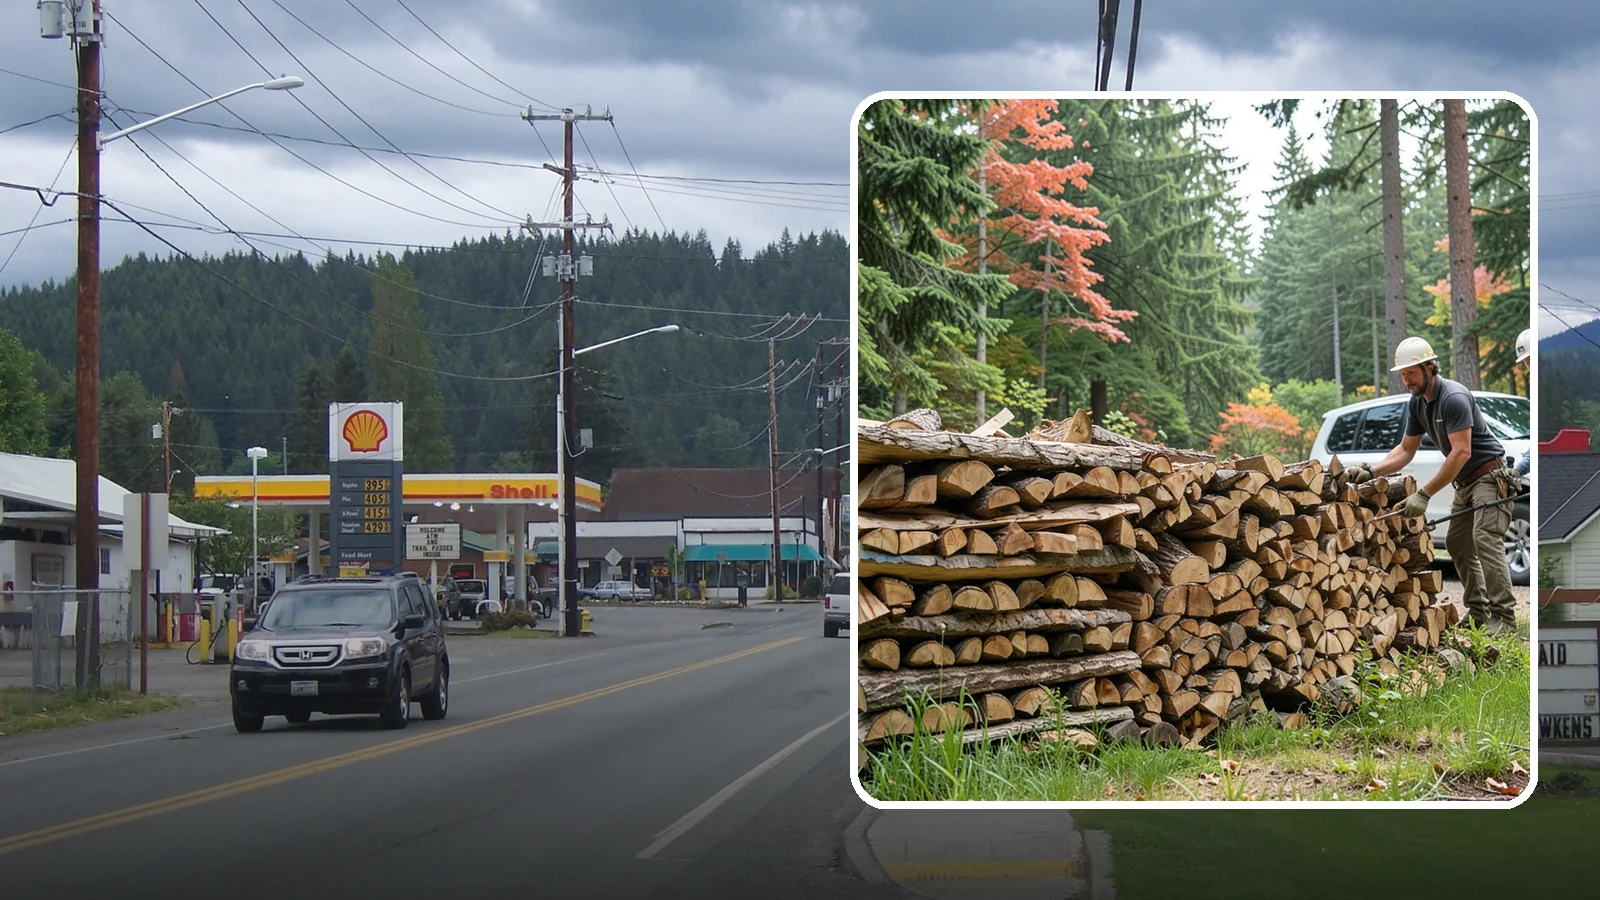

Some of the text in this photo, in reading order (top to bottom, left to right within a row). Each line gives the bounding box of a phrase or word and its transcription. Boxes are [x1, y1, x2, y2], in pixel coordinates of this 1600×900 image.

[365, 479, 383, 490] 395
[490, 484, 547, 498] Shell
[365, 494, 383, 504] 405
[365, 508, 383, 518] 415
[365, 522, 383, 533] 429
[1538, 642, 1566, 665] AID
